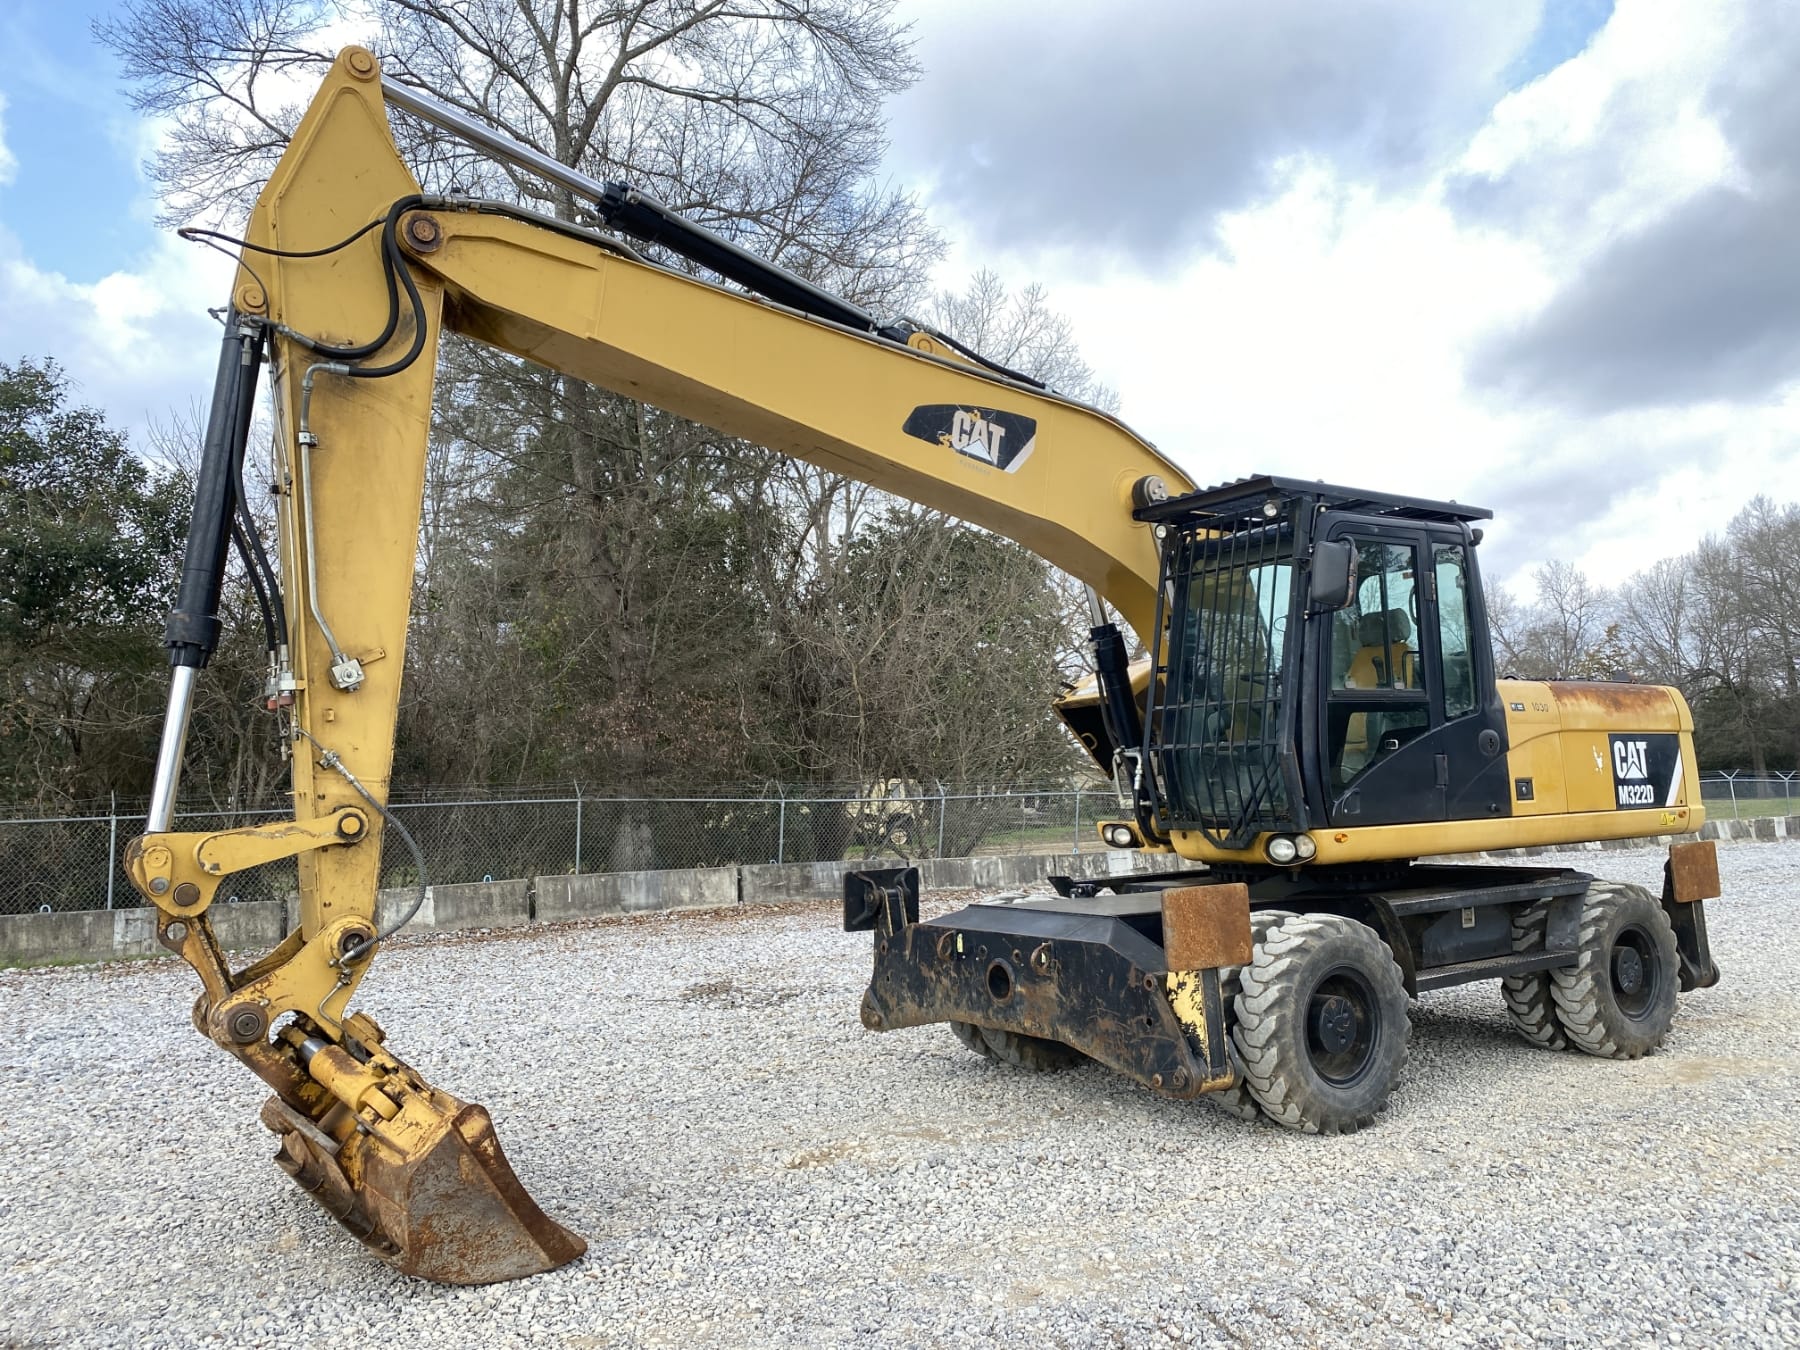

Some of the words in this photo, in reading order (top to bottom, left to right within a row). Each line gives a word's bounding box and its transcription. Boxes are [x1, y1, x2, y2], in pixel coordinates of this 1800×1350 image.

[952, 410, 1005, 465] CAT
[1613, 740, 1648, 779] CAT
[1618, 784, 1654, 805] M322D
